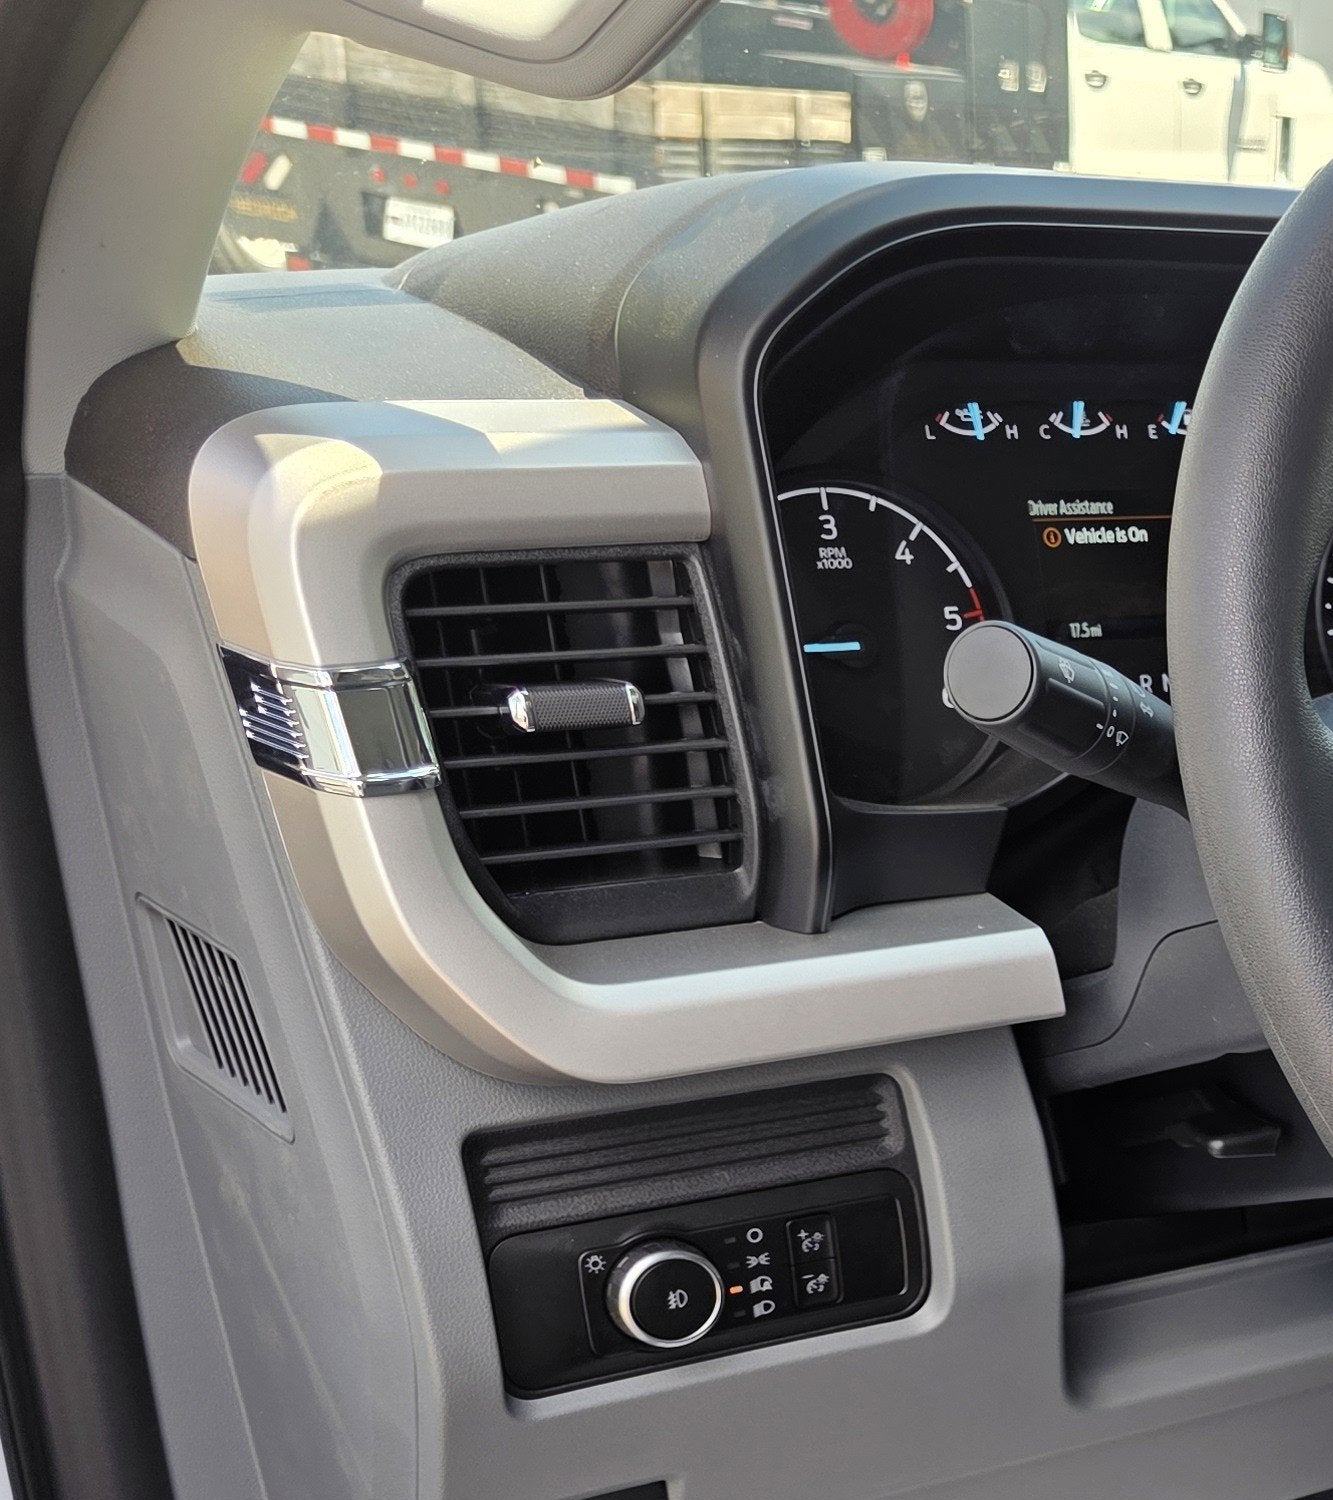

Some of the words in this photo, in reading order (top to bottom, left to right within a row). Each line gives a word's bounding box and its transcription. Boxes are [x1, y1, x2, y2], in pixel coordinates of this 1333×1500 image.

[924, 424, 936, 440] L
[1005, 424, 1019, 439] H
[1038, 424, 1051, 439] C
[1115, 424, 1128, 439] H
[1147, 424, 1159, 439] E
[1027, 500, 1058, 516] Driver
[1059, 499, 1114, 515] Assistance
[819, 514, 838, 540] 3
[1063, 527, 1115, 545] Vehicle
[1115, 526, 1127, 543] is
[1127, 525, 1149, 543] On
[818, 547, 847, 560] RPM
[895, 541, 914, 564] 4
[816, 557, 853, 571] x1000
[943, 606, 963, 631] 5
[1139, 674, 1153, 693] R
